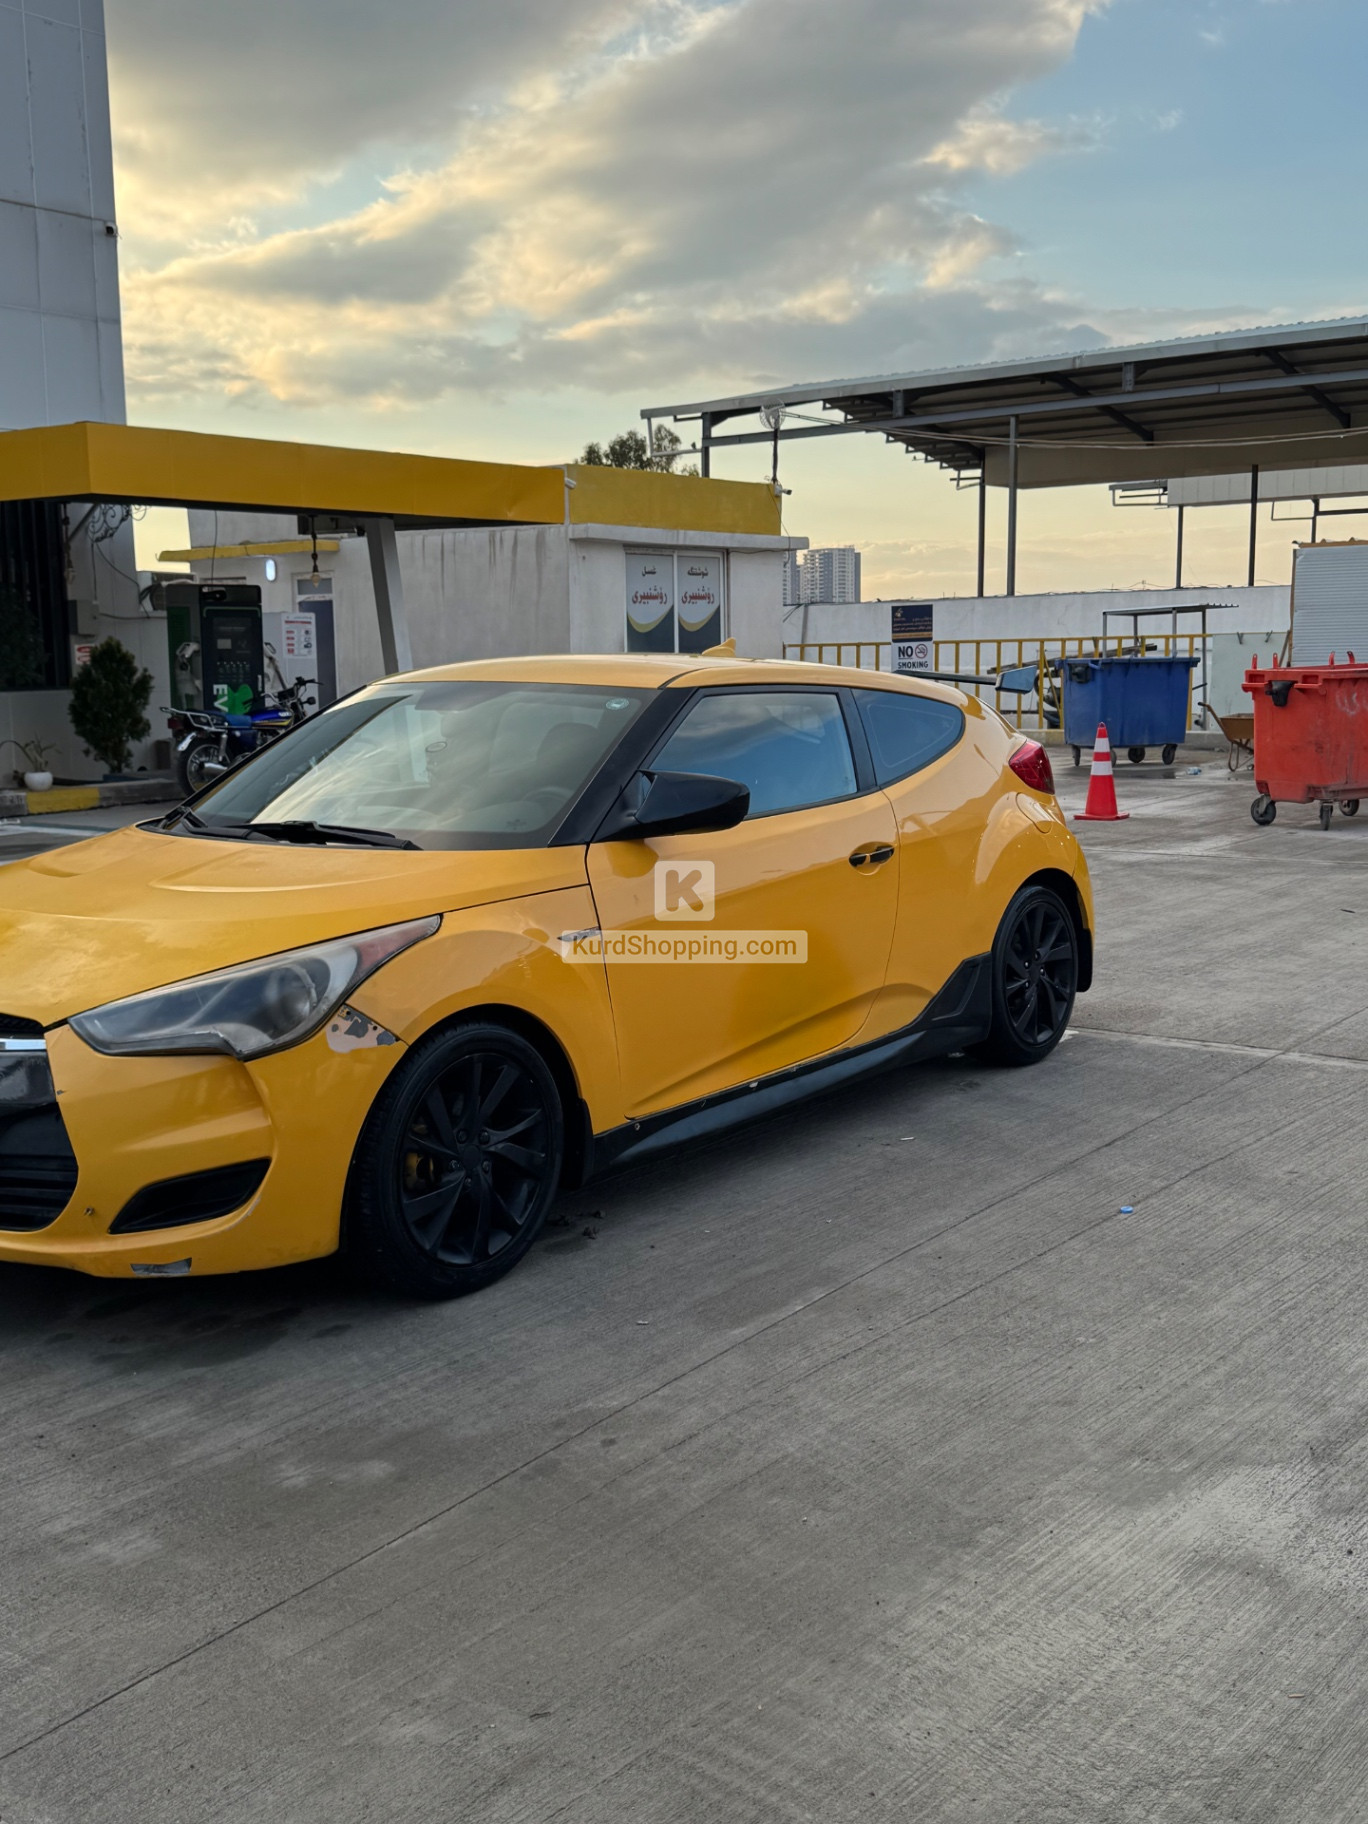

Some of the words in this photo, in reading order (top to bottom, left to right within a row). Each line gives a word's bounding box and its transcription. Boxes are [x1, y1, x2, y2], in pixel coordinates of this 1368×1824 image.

[898, 645, 914, 658] NO
[898, 661, 929, 669] SMOKING
[213, 684, 229, 712] EV
